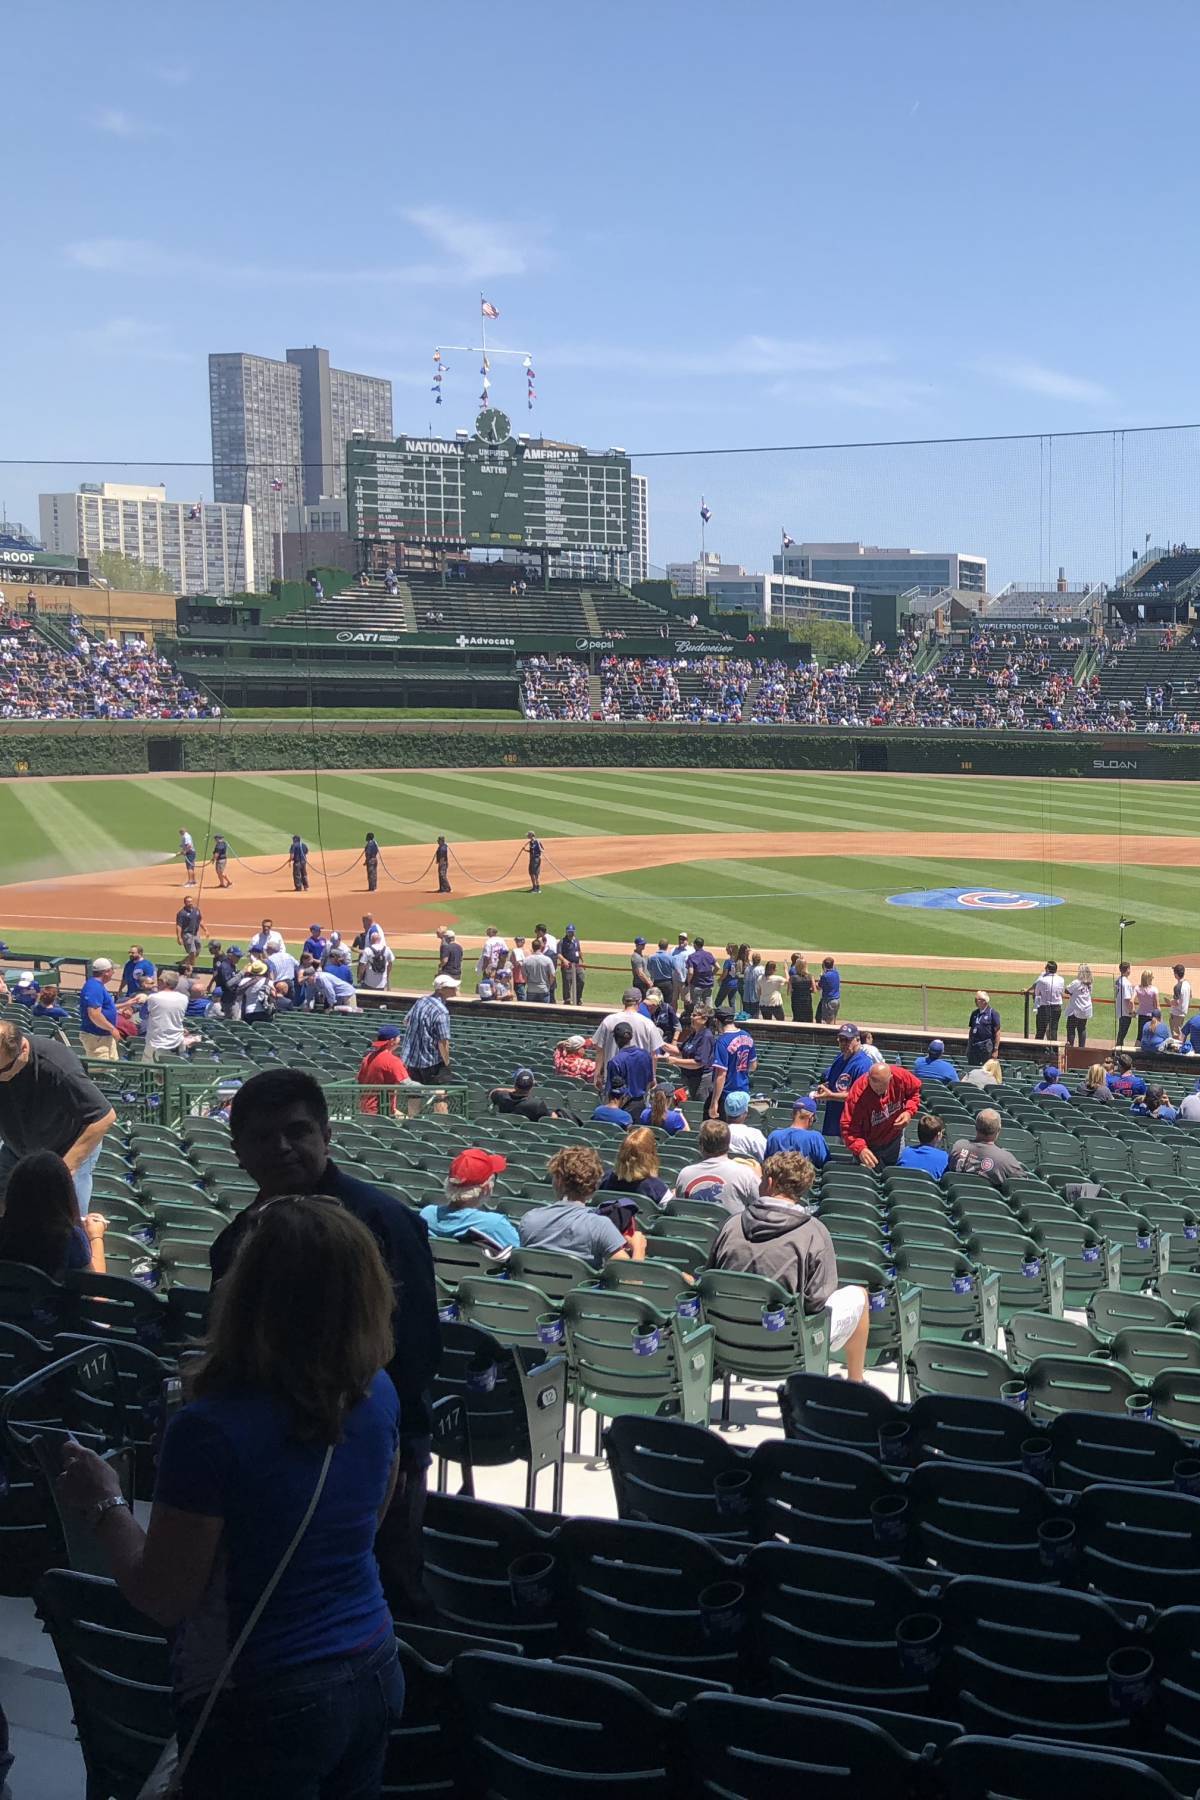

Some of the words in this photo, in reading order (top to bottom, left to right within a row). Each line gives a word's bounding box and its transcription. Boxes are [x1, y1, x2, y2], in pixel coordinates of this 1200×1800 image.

[405, 440, 465, 455] NATIONAL
[478, 448, 510, 457] UMPIRES
[523, 449, 579, 462] AMERICAN
[480, 465, 508, 475] BATTER
[353, 633, 377, 642] ATI
[470, 636, 515, 645] Advocate
[589, 640, 614, 649] pepsi
[675, 640, 734, 653] Budweiser
[1093, 760, 1137, 769] SLOAN
[83, 1352, 107, 1379] 117
[544, 1391, 554, 1402] 12
[439, 1407, 460, 1436] 117
